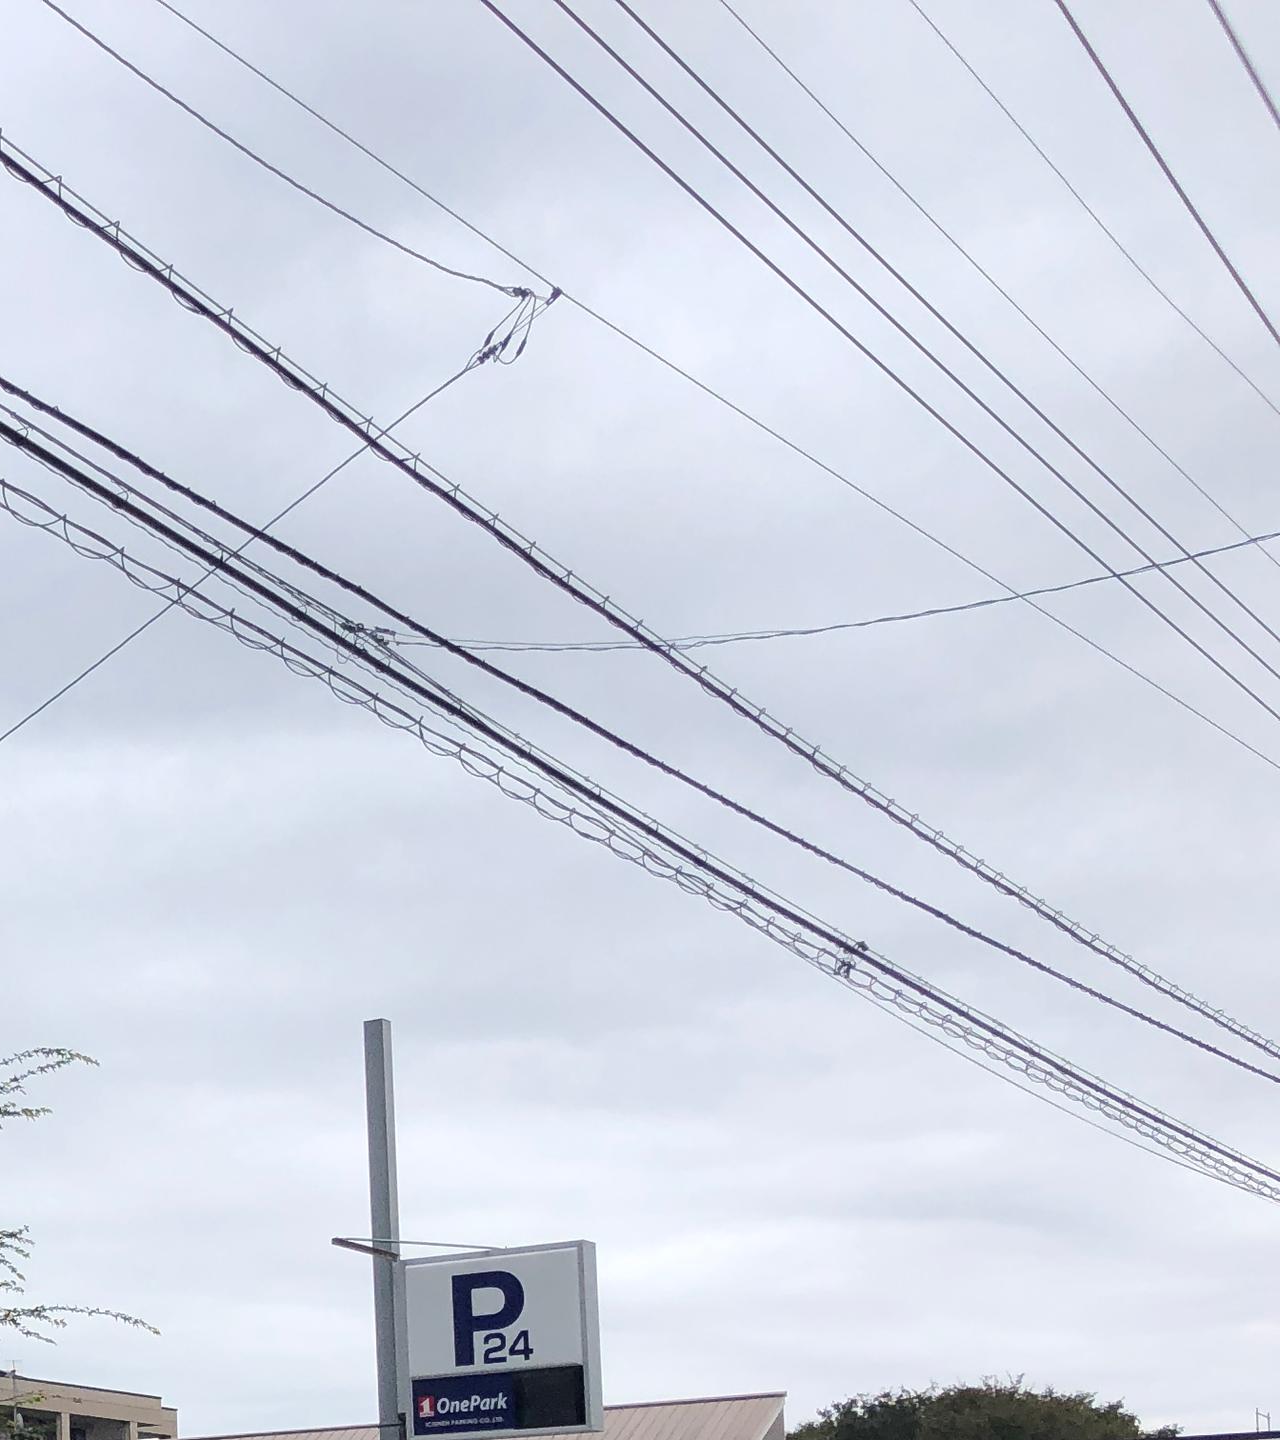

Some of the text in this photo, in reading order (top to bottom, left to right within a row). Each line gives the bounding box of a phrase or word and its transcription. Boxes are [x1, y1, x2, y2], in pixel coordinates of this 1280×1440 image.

[451, 1270, 534, 1367] P 24
[436, 1392, 507, 1414] OnePark
